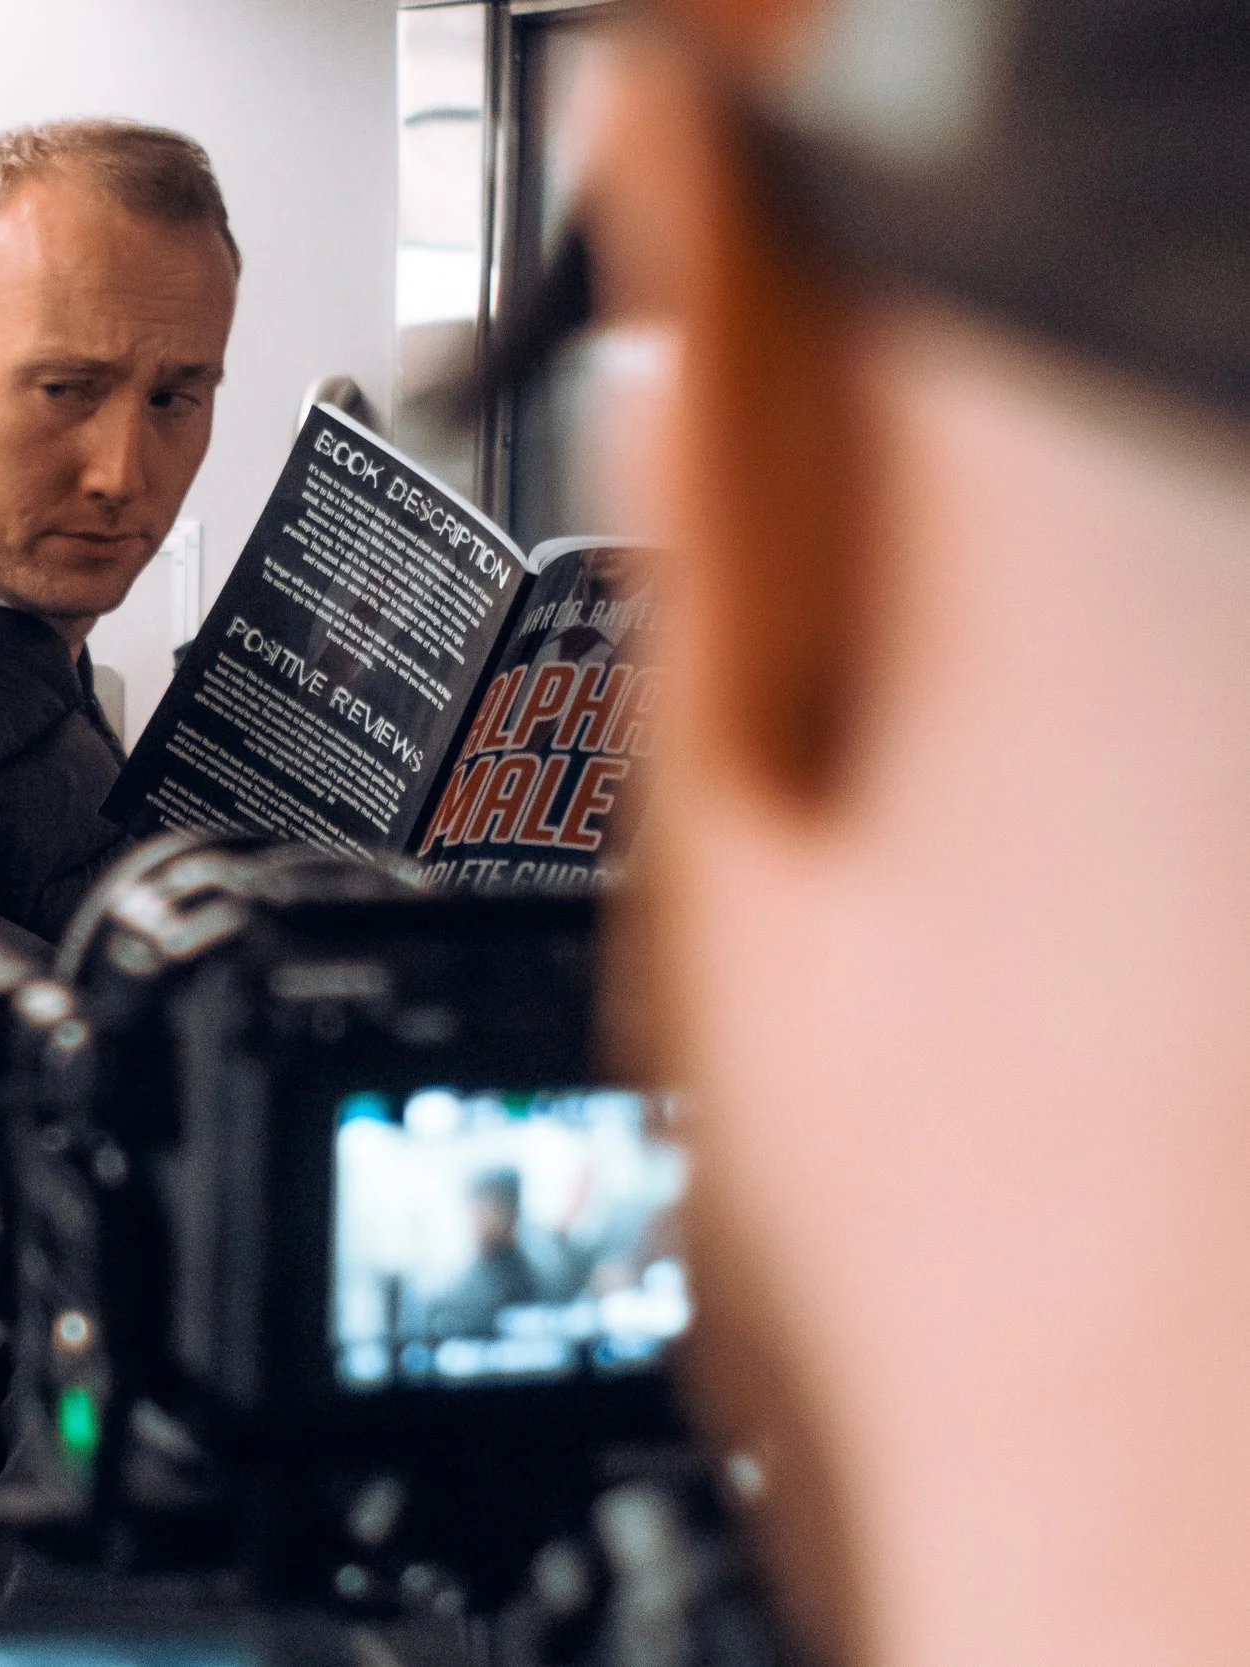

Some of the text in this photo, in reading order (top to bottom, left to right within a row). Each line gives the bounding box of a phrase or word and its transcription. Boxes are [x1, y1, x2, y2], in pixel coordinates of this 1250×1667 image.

[312, 427, 512, 590] BOOK DESCRIPTION
[318, 469, 334, 485] time
[332, 479, 341, 490] to
[337, 483, 355, 502] stop
[351, 492, 376, 516] always
[372, 507, 392, 527] being
[389, 518, 398, 529] in
[395, 522, 418, 543] second
[414, 536, 433, 557] place
[430, 547, 443, 563] and
[453, 569, 463, 582] up
[461, 574, 469, 586] to
[304, 476, 320, 491] how
[318, 485, 328, 496] to
[325, 489, 336, 502] be
[333, 496, 340, 505] a
[338, 498, 355, 514] True
[351, 507, 371, 528] Alpha
[368, 518, 385, 535] Male
[381, 529, 407, 554] through
[404, 544, 424, 565] secret
[470, 598, 478, 609] in
[270, 560, 293, 583] longer
[290, 573, 304, 588] will
[305, 507, 468, 634] become an Alpha Male, and this ebook takes you to that status
[333, 510, 345, 523] off
[342, 516, 358, 532] that
[355, 525, 372, 542] Beta
[369, 535, 386, 552] Male
[423, 574, 434, 588] for
[469, 615, 480, 629] can
[280, 522, 311, 549] practice.
[308, 539, 323, 555] This
[320, 548, 340, 566] ebook
[338, 559, 352, 574] will
[349, 567, 369, 586] teach
[365, 581, 379, 596] you
[376, 587, 391, 603] how
[389, 596, 398, 609] to
[394, 601, 419, 627] capture
[416, 617, 427, 631] all
[424, 623, 441, 643] those
[438, 635, 445, 646] 3
[300, 582, 314, 598] you
[312, 588, 323, 602] be
[333, 541, 346, 555] It's
[344, 548, 354, 560] all
[351, 553, 361, 565] in
[358, 558, 371, 572] the
[367, 565, 387, 586] mind,
[384, 576, 397, 591] the
[393, 585, 414, 606] proper
[441, 622, 453, 638] and
[301, 550, 316, 565] and
[312, 559, 334, 578] renew
[331, 572, 347, 589] your
[346, 580, 363, 598] view
[360, 590, 370, 603] of
[366, 595, 381, 613] life,
[378, 604, 392, 619] and
[408, 627, 424, 645] view
[421, 637, 431, 650] of
[320, 596, 337, 612] seen
[335, 606, 345, 617] as
[343, 611, 350, 621] a
[518, 600, 583, 639] MARCO
[346, 613, 366, 634] Beta,
[362, 624, 376, 639] but
[260, 569, 275, 584] The
[271, 576, 294, 596] secret
[289, 589, 305, 607] tips
[303, 597, 318, 613] this
[314, 605, 334, 624] ebook
[332, 617, 346, 632] will
[343, 625, 363, 644] share
[360, 636, 374, 652] will
[370, 646, 386, 663] wow
[383, 657, 398, 675] you,
[396, 665, 410, 681] and
[406, 676, 419, 692] you
[436, 699, 445, 712] to
[325, 627, 344, 646] know
[373, 633, 387, 648] now
[385, 642, 395, 654] as
[393, 648, 400, 658] a
[396, 650, 413, 670] pack
[224, 615, 423, 774] POSITIVE REVIEWS
[454, 661, 662, 770] ALPHA
[310, 729, 322, 743] my
[417, 752, 630, 858] MALE
